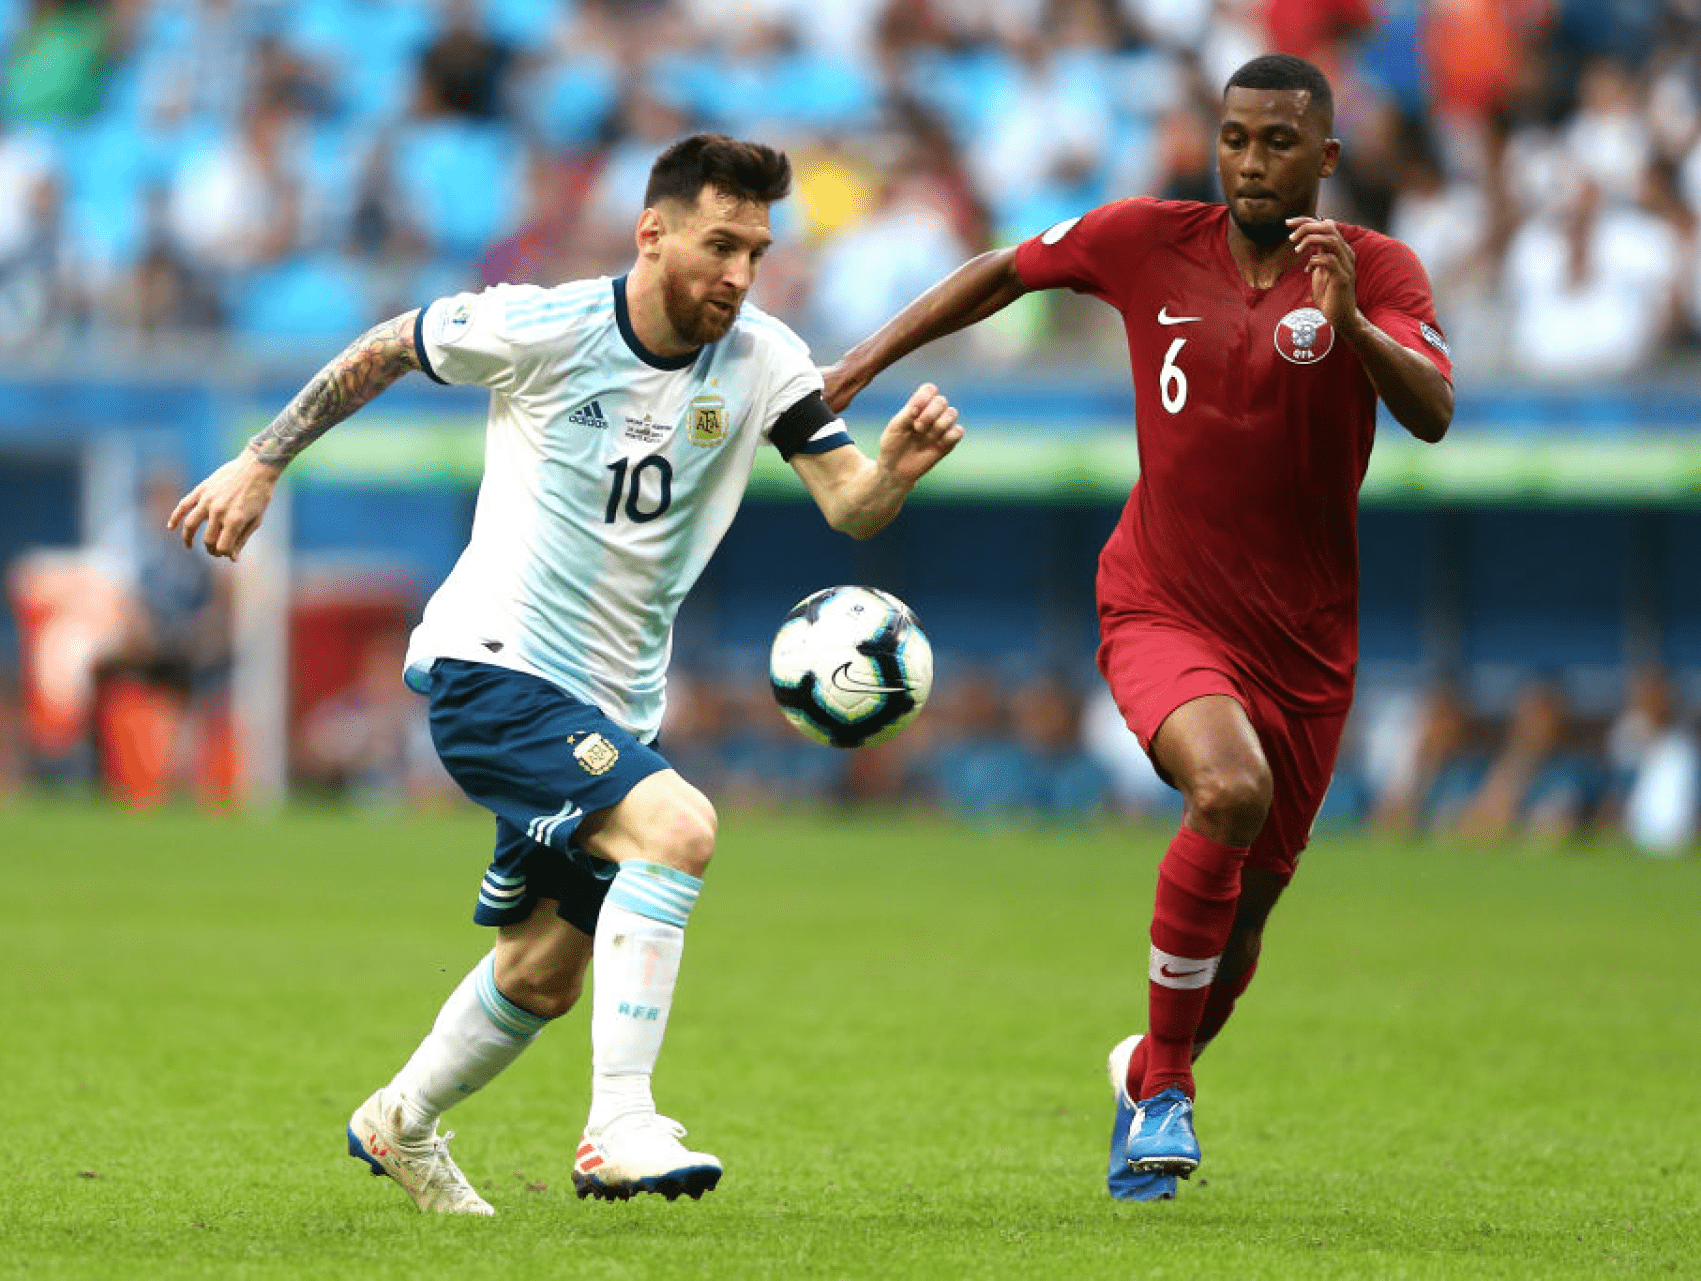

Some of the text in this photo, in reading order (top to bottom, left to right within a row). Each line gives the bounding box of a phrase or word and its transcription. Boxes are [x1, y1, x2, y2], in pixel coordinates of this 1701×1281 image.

[1159, 337, 1188, 414] 6
[568, 414, 609, 430] adidas
[696, 410, 720, 434] AFA
[604, 453, 674, 524] 10
